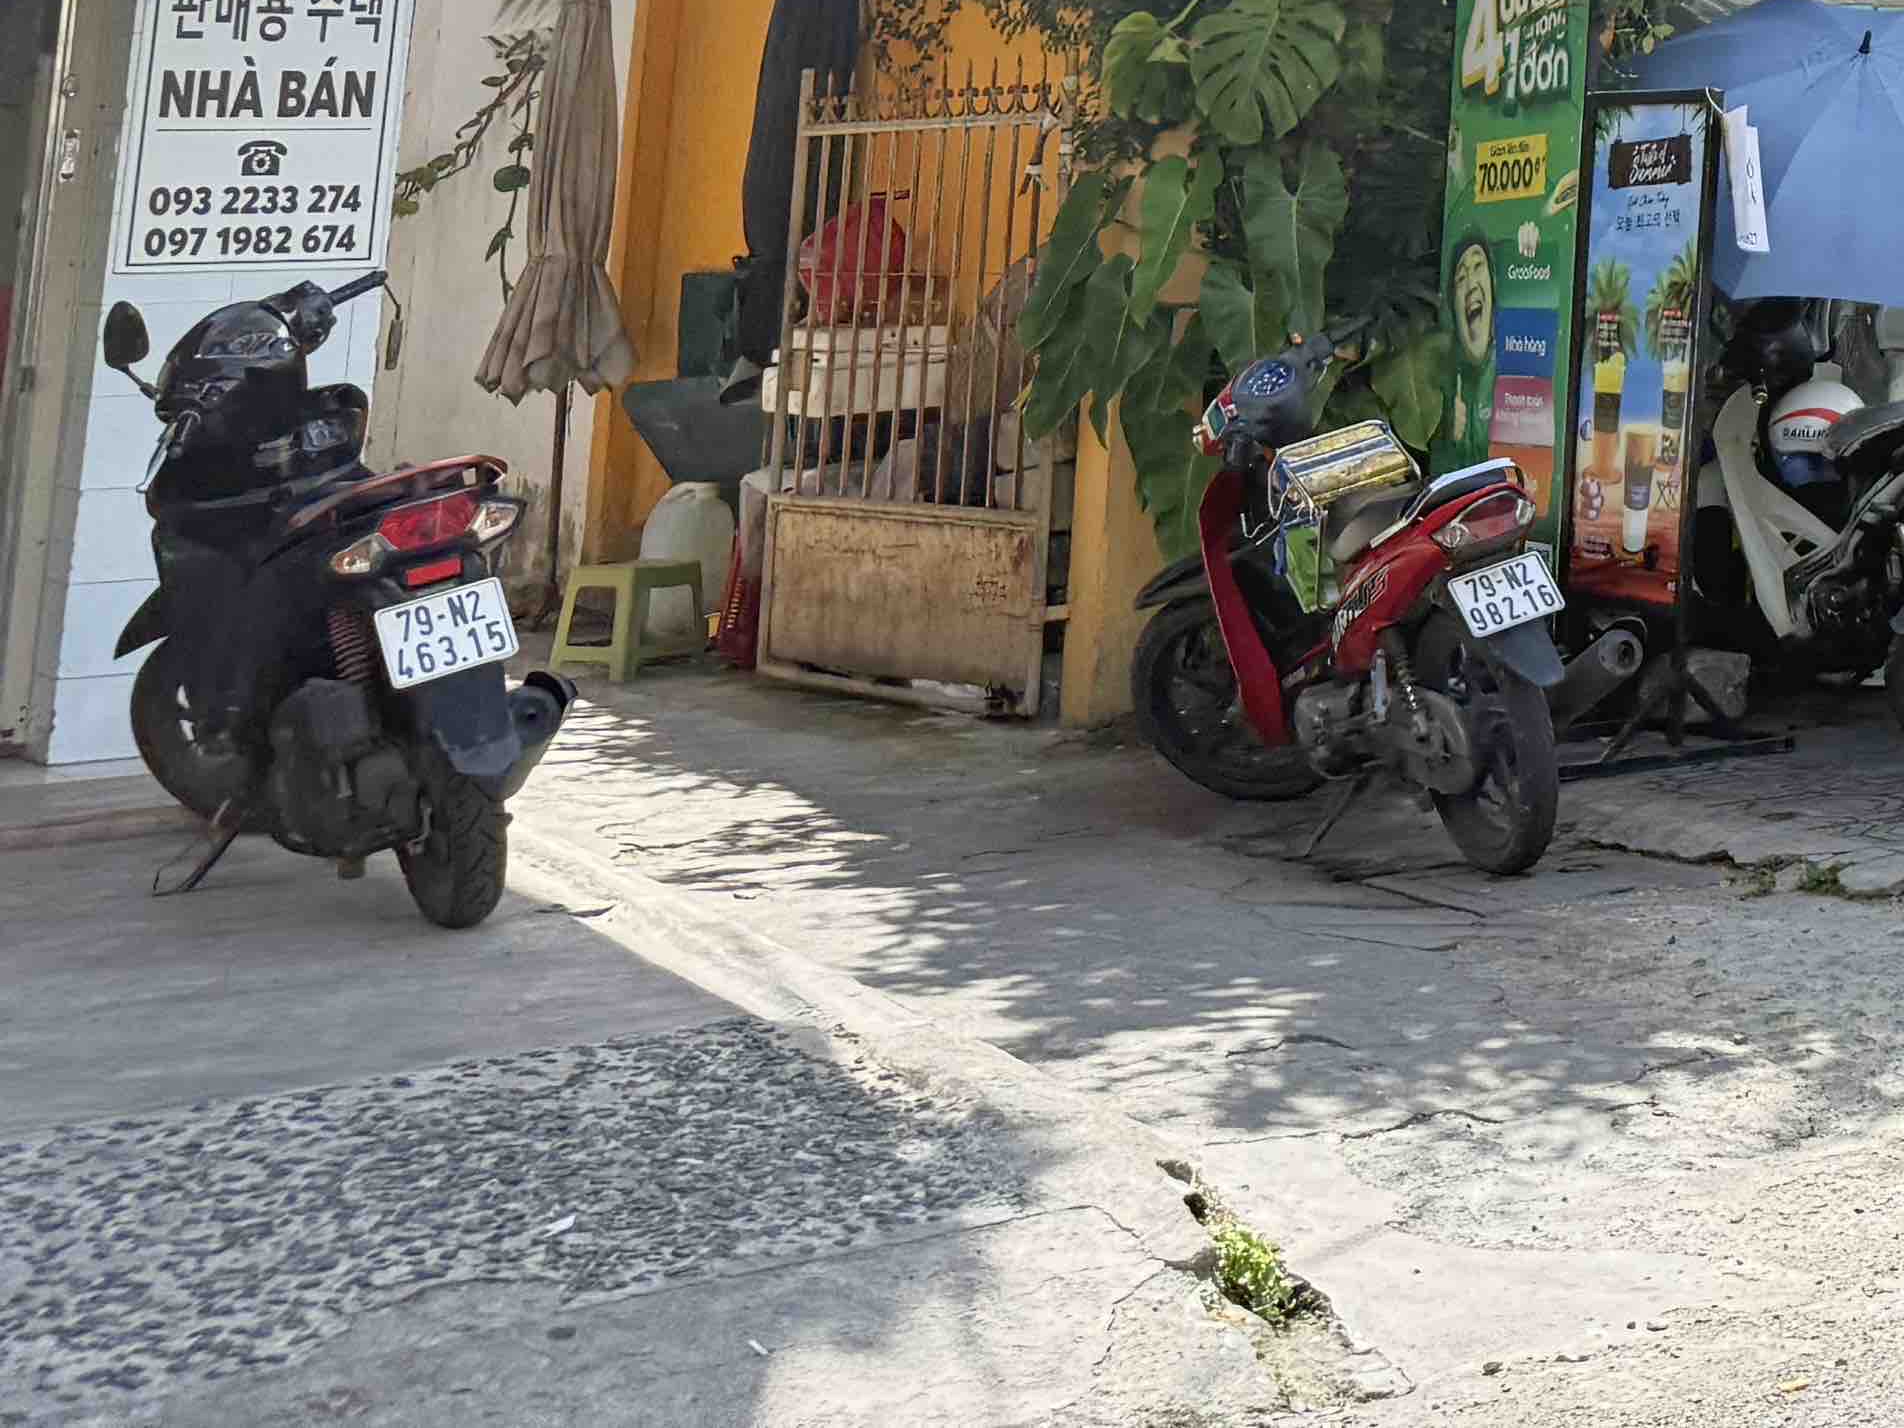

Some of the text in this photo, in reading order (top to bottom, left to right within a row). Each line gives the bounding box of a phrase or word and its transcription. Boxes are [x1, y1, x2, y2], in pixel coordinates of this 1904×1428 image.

[158, 55, 377, 119] NHÀ BÁN
[148, 184, 361, 217] 093 2233 274
[144, 224, 356, 257] 097 1982 674
[1464, 562, 1535, 603] 79-N2
[395, 590, 486, 643] 79-N2
[1469, 584, 1556, 632] 982.16
[398, 620, 506, 679] 463.15
